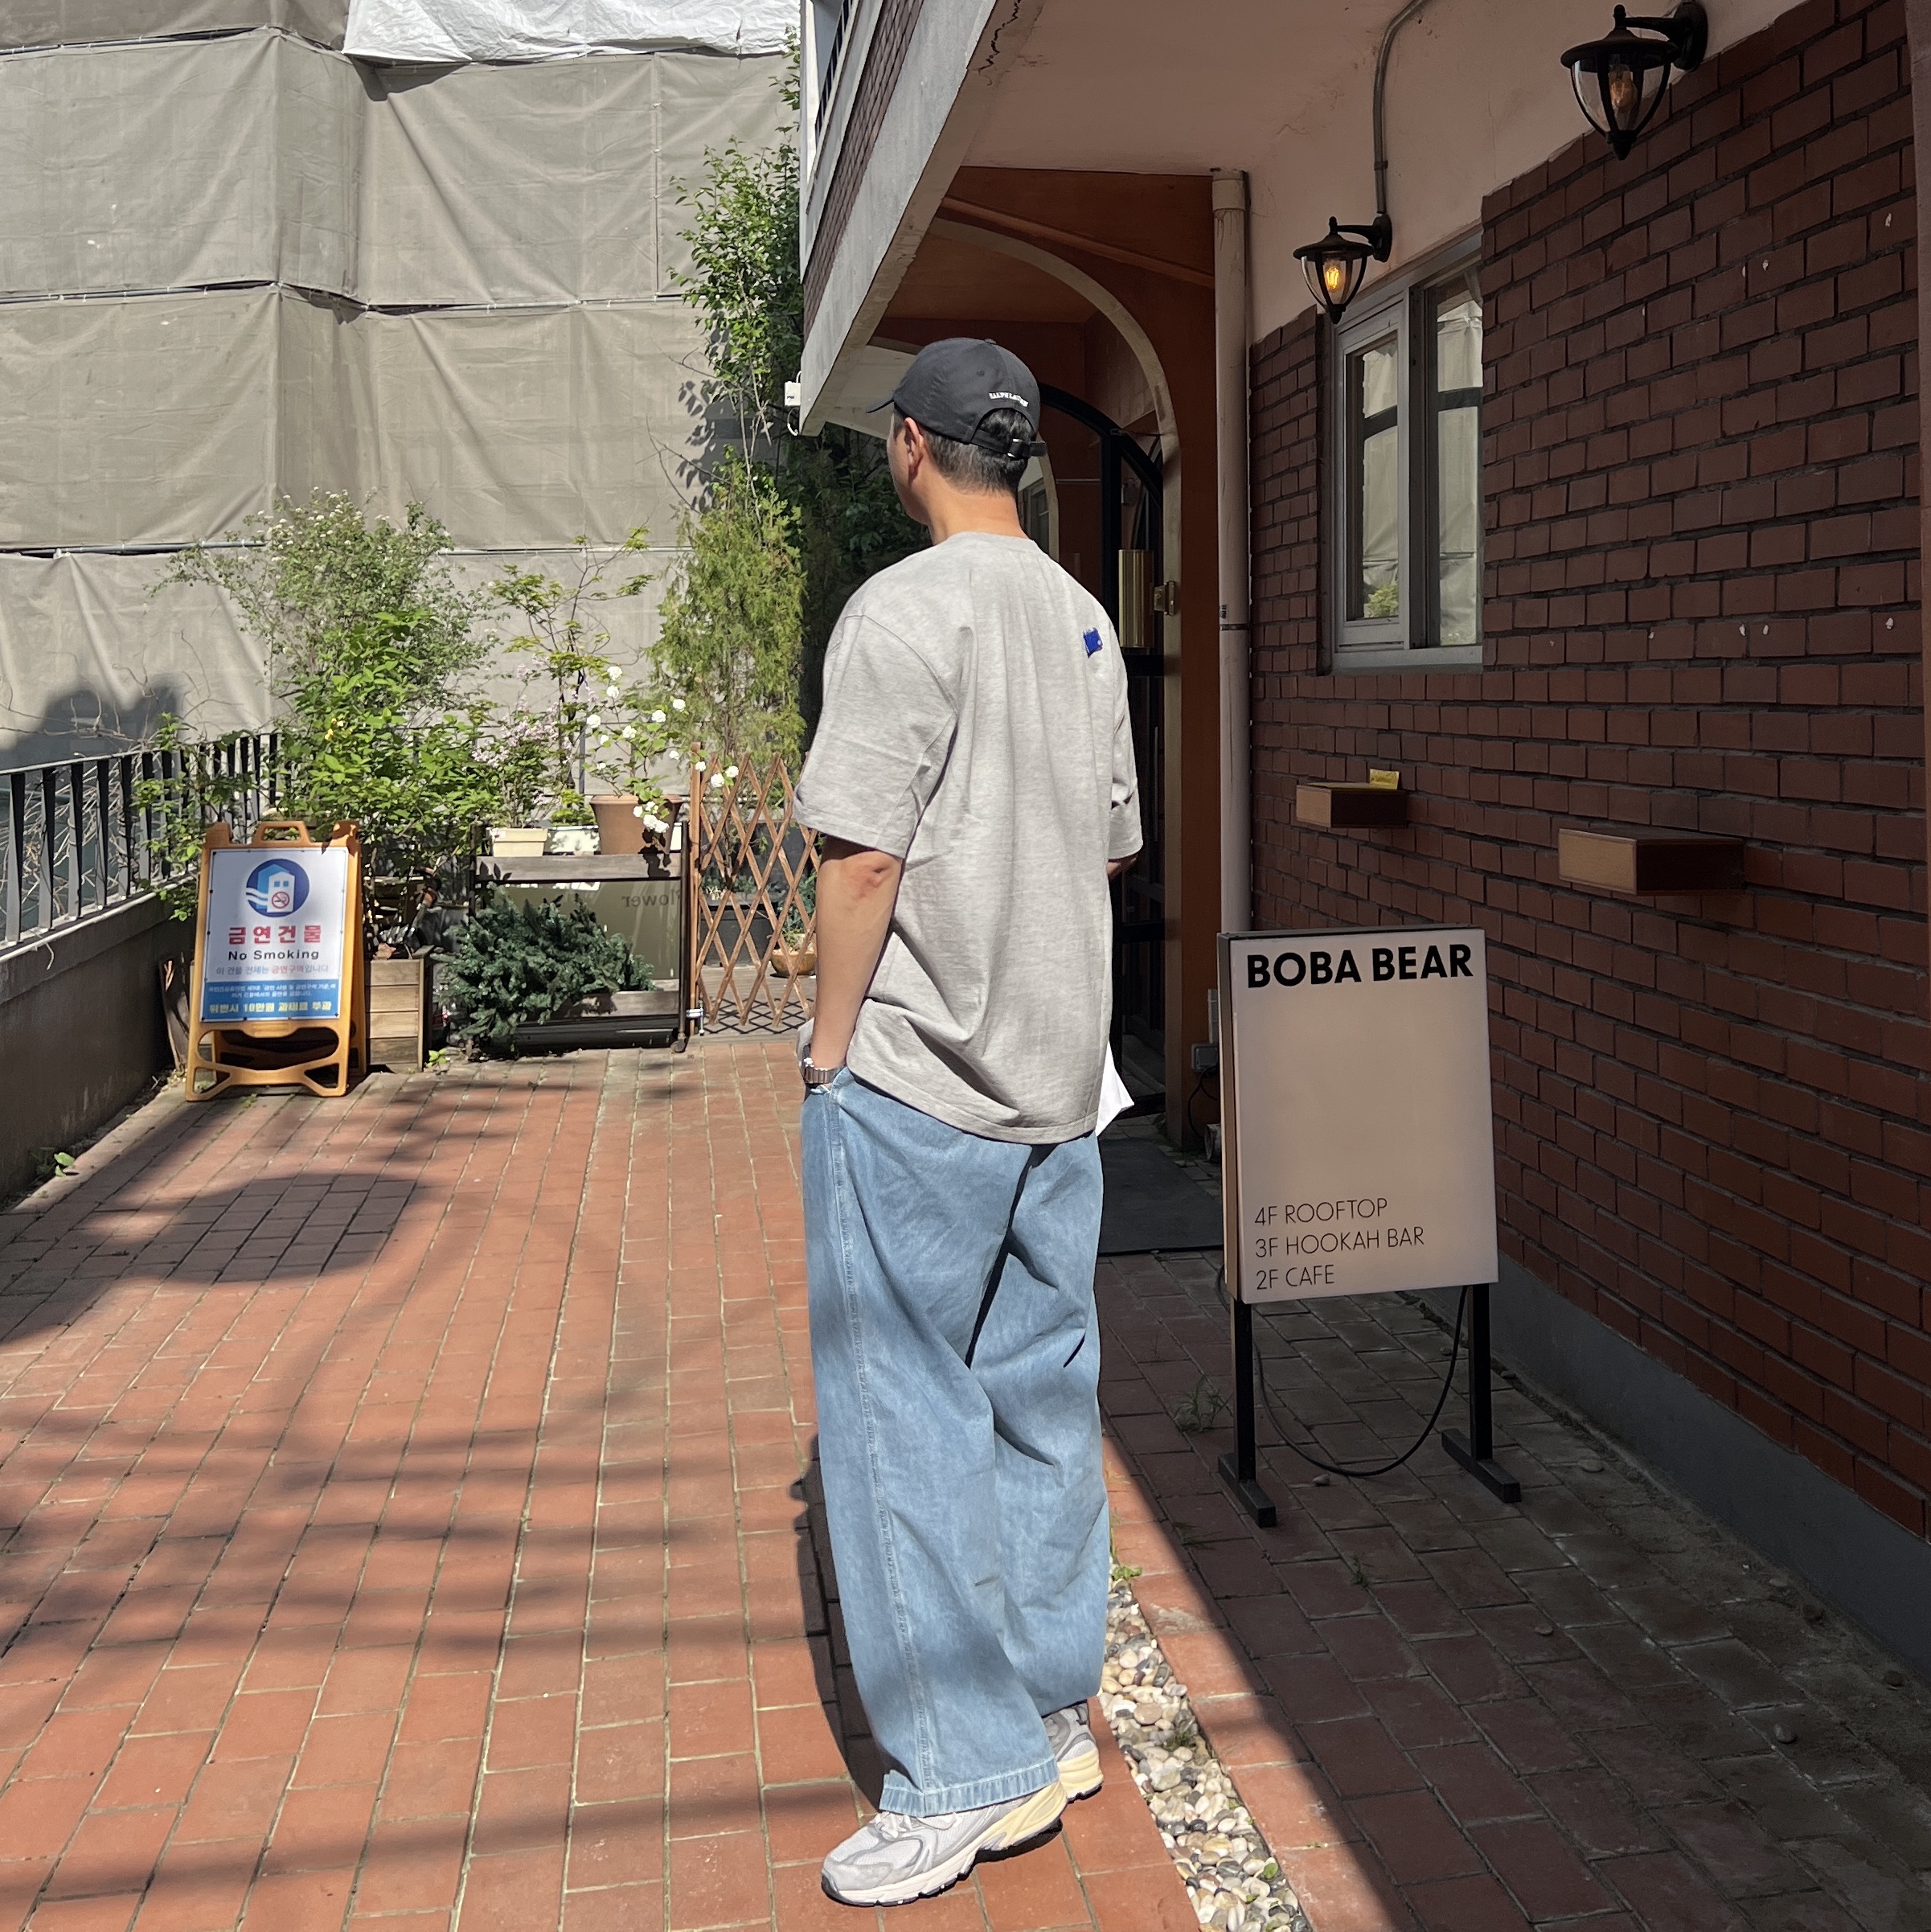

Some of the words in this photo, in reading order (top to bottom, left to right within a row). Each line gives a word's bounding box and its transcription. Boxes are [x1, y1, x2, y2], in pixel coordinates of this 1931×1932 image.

[228, 925, 322, 945] 금연건물
[228, 951, 247, 961] No
[253, 950, 319, 960] Smoking
[1247, 950, 1362, 988] BOBA
[1371, 944, 1474, 982] BEAR
[1254, 1205, 1278, 1226] 4F
[1285, 1198, 1388, 1224] ROOFTOP
[1255, 1237, 1278, 1258] 3F
[1286, 1230, 1380, 1256] HOOKAH
[1388, 1226, 1425, 1248] BAR
[1256, 1269, 1278, 1290] 2F
[1285, 1265, 1334, 1287] CAFE
